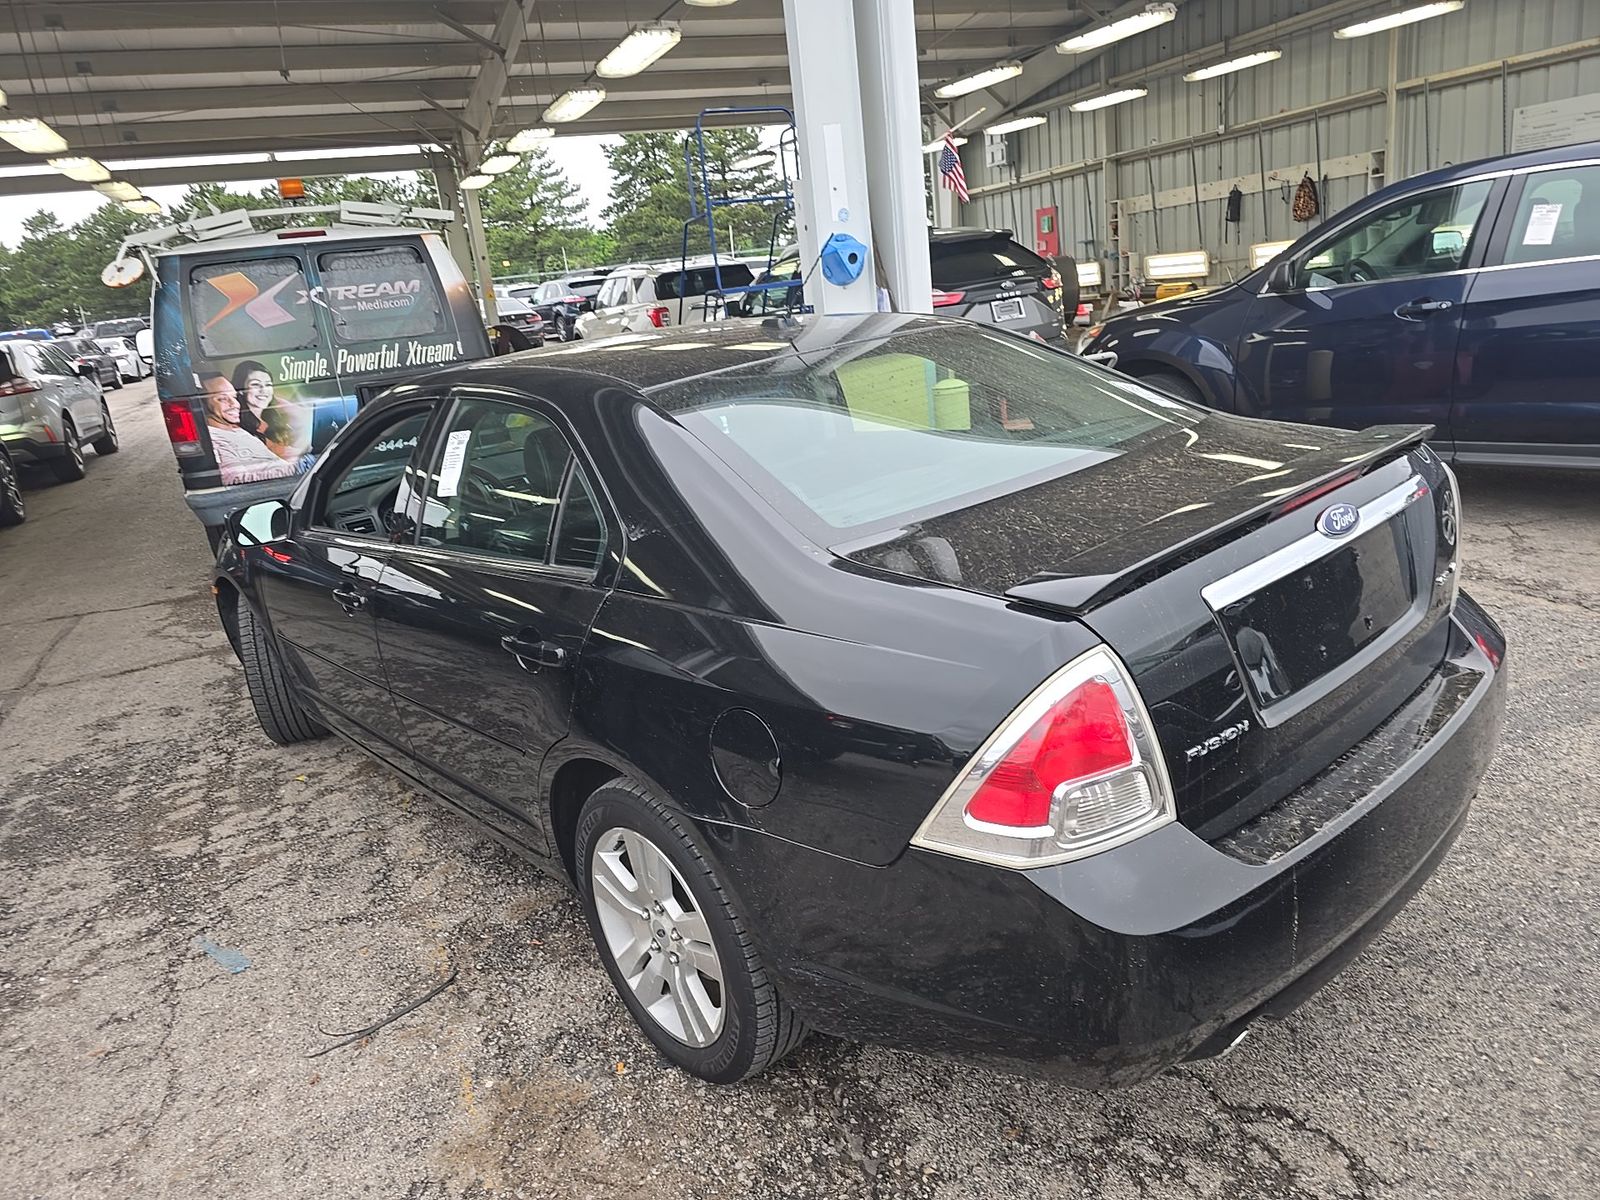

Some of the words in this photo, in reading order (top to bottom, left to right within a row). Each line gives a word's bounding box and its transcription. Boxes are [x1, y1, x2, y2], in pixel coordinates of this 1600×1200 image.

[357, 298, 411, 312] Mediacom
[279, 352, 331, 384] Simple.
[336, 343, 402, 374] Powerful.
[405, 340, 458, 367] Xtream.
[372, 436, 420, 452] -844-4
[1330, 507, 1356, 531] Ford
[1184, 719, 1250, 762] FUSION
